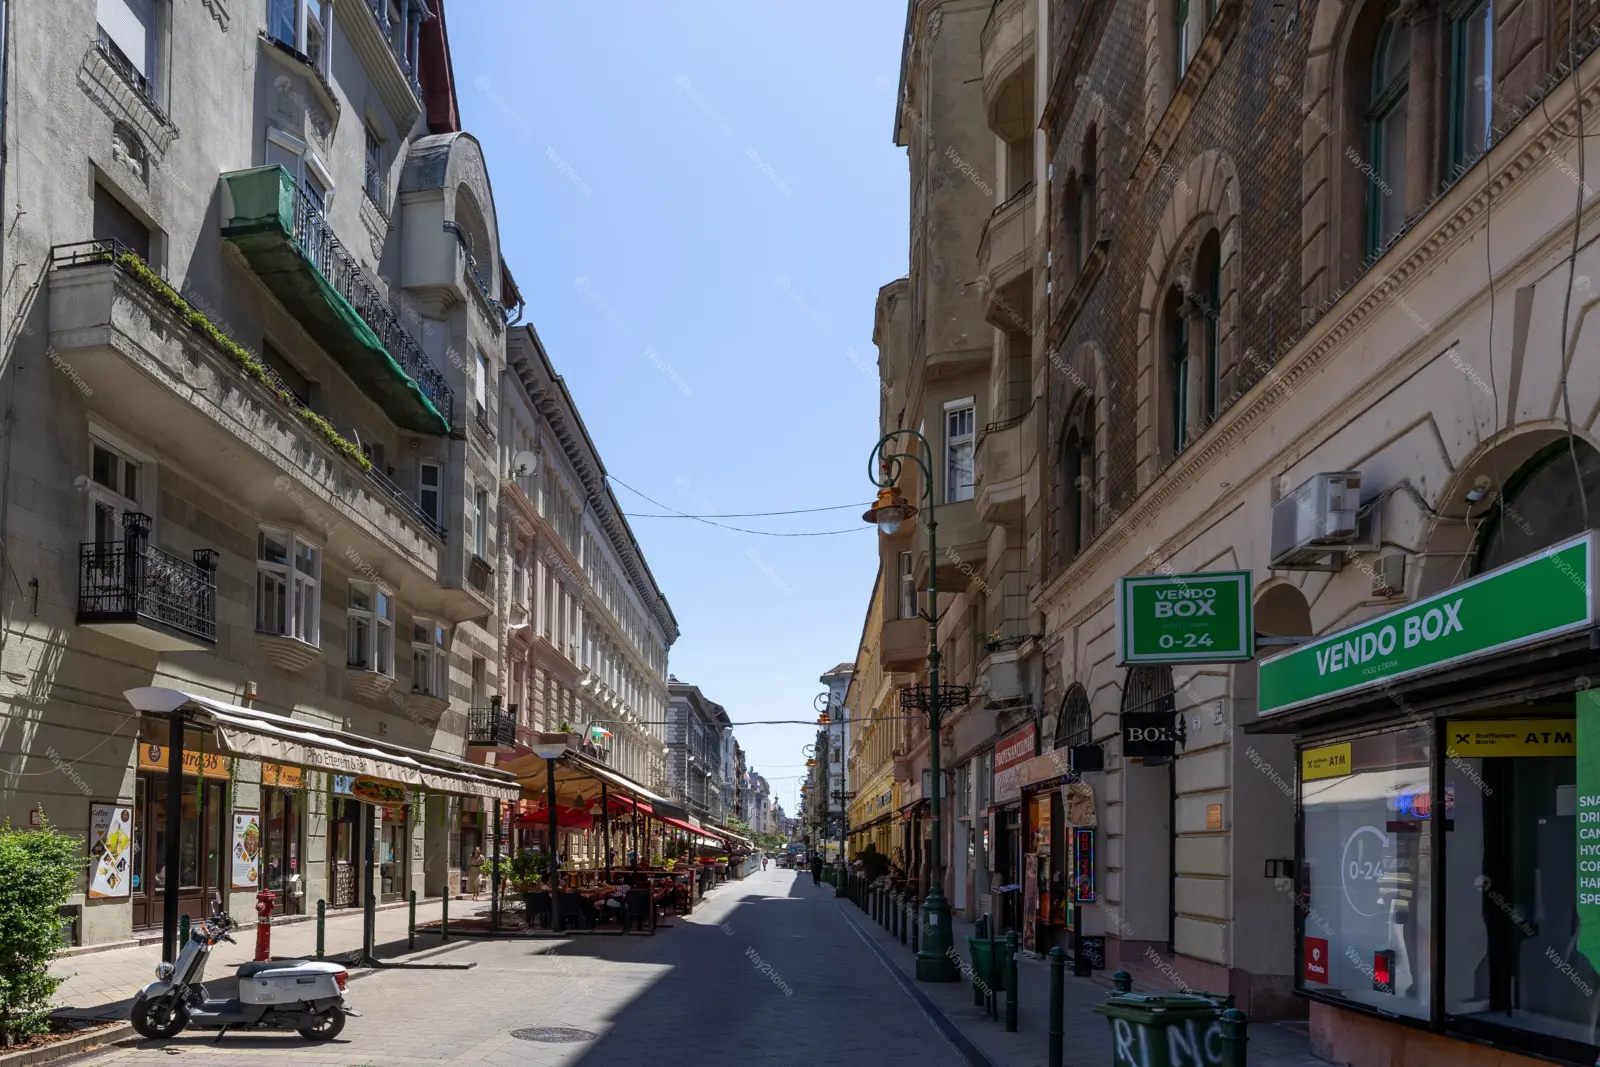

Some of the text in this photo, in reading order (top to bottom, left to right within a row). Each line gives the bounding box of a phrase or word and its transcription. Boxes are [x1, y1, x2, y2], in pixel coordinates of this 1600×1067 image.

[1156, 588, 1216, 600] VENDO
[1155, 599, 1216, 618] BOX
[1159, 633, 1213, 648] 0-24
[1316, 598, 1464, 676] VENDO BOX
[1362, 666, 1376, 675] FOOD
[1382, 660, 1398, 671] DRINK
[1525, 731, 1573, 744] ATM
[350, 761, 357, 772] &
[1329, 755, 1346, 767] ATM
[92, 809, 108, 817] Coffee
[1580, 812, 1600, 823] DRI
[1350, 861, 1384, 880] 0-24
